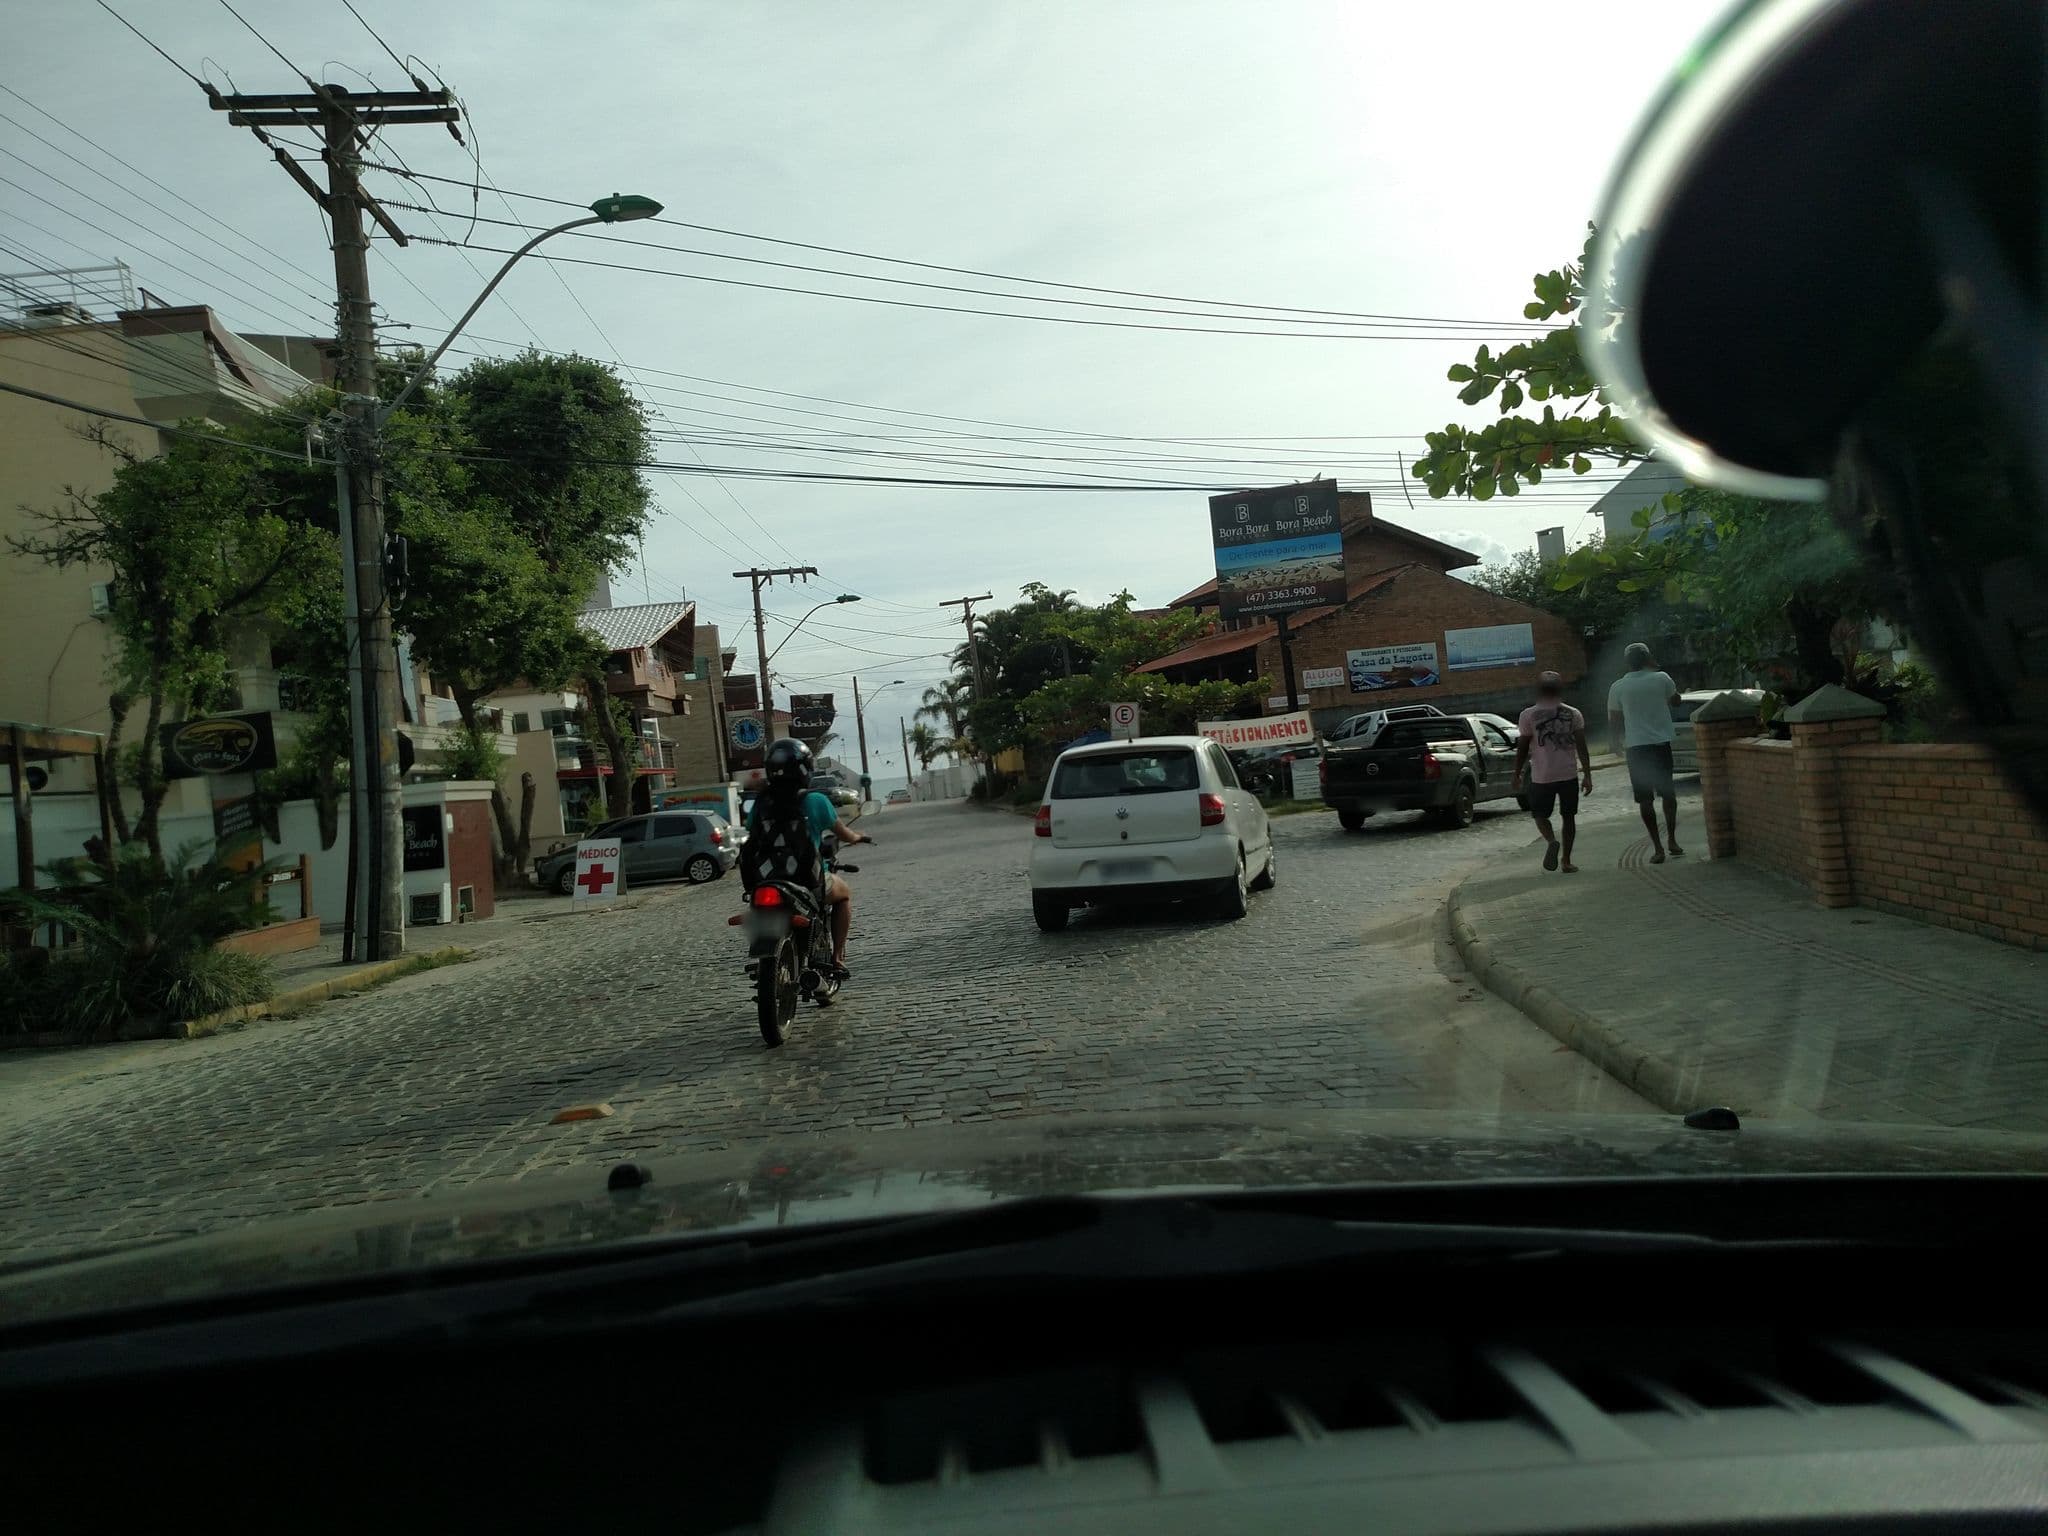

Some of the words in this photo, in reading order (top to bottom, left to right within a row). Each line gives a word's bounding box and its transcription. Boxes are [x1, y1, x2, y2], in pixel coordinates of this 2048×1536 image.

[1276, 519, 1300, 531] Bora
[1302, 509, 1333, 527] Beach
[1219, 527, 1243, 538] Bora
[1245, 524, 1270, 535] Bora
[1246, 592, 1265, 605] (47)
[1267, 586, 1317, 600] 3363.9900
[1351, 658, 1376, 668] Casa
[1378, 655, 1391, 665] da
[1393, 652, 1434, 665] Lagosta
[1121, 708, 1129, 720] E
[409, 833, 438, 850] Beach
[577, 846, 619, 860] MÉDICO
